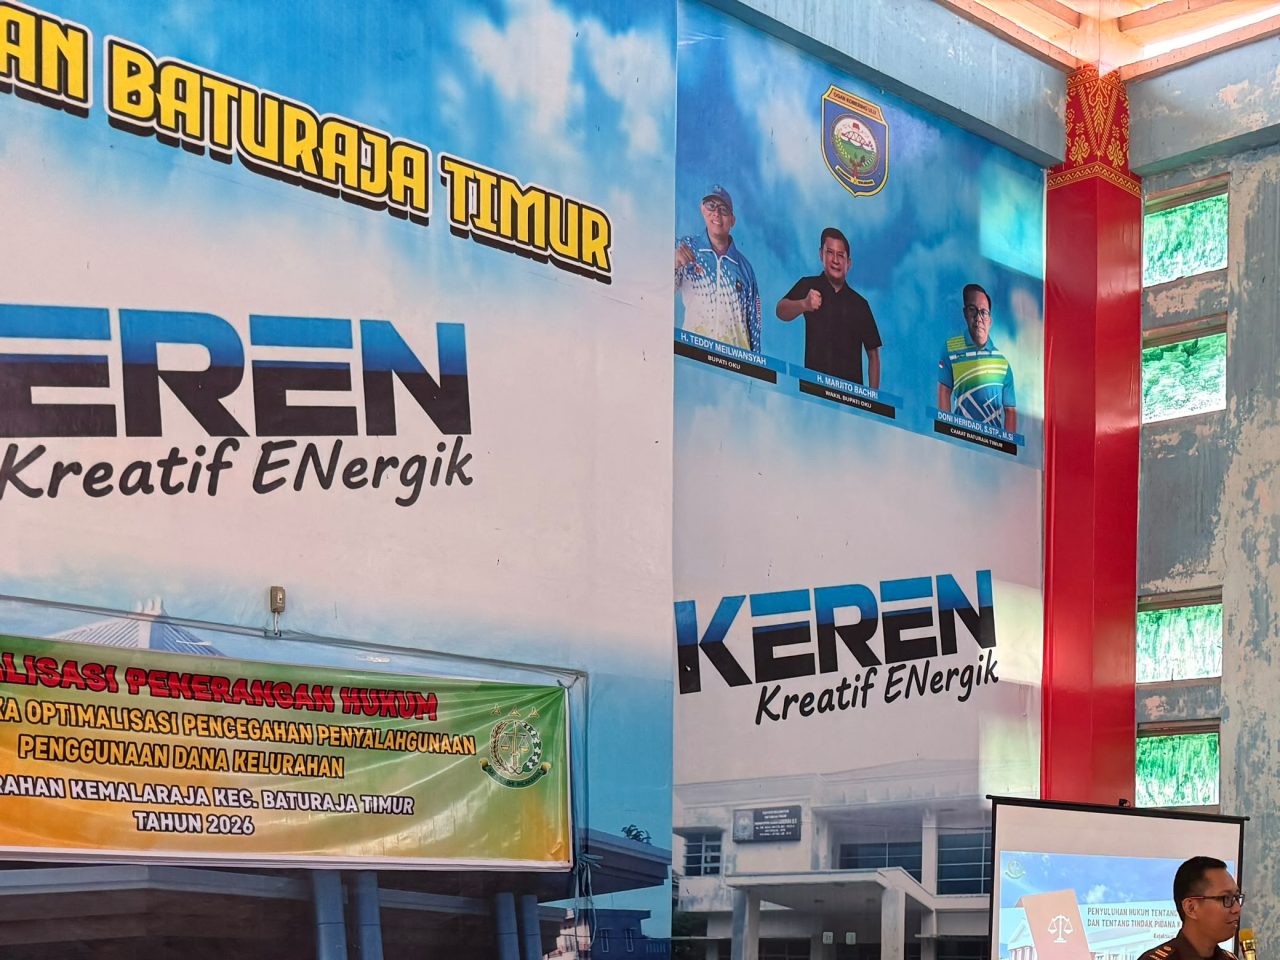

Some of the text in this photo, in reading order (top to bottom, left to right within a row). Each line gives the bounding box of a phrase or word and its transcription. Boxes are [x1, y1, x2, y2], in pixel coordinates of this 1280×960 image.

[107, 39, 431, 222] BATURAJA
[441, 155, 613, 282] TIMUR
[680, 332, 767, 366] H. TEDDY MEILWANSYAH
[707, 355, 741, 370] BUPATI OKU
[853, 385, 879, 400] BACHRI
[937, 411, 953, 422] DONI
[0, 435, 473, 506] Kreatif ENergik
[674, 569, 997, 694] KEREN
[0, 653, 438, 721] LISASI PENERANGAN HUKUM
[754, 649, 999, 725] Kreatif ENergik
[25, 700, 178, 735] OPTIMALISASI
[183, 713, 313, 745] PENCEGAHAN
[317, 724, 476, 756] PENYALAHGUNAAN
[18, 734, 344, 778] PENGGUNAAN DANA KELURAHAN
[0, 775, 414, 815] AHAN KEMALARAJA KEC. BATURAJA TIMUR
[133, 811, 254, 835] TAHUN 2026
[1087, 907, 1128, 916] PENYULUHAN
[1129, 908, 1150, 917] HUKUM
[1087, 918, 1100, 927] DAN
[1102, 919, 1130, 927] TENTANG
[1131, 920, 1153, 928] TINDAK
[1154, 920, 1176, 928] PIDANA
